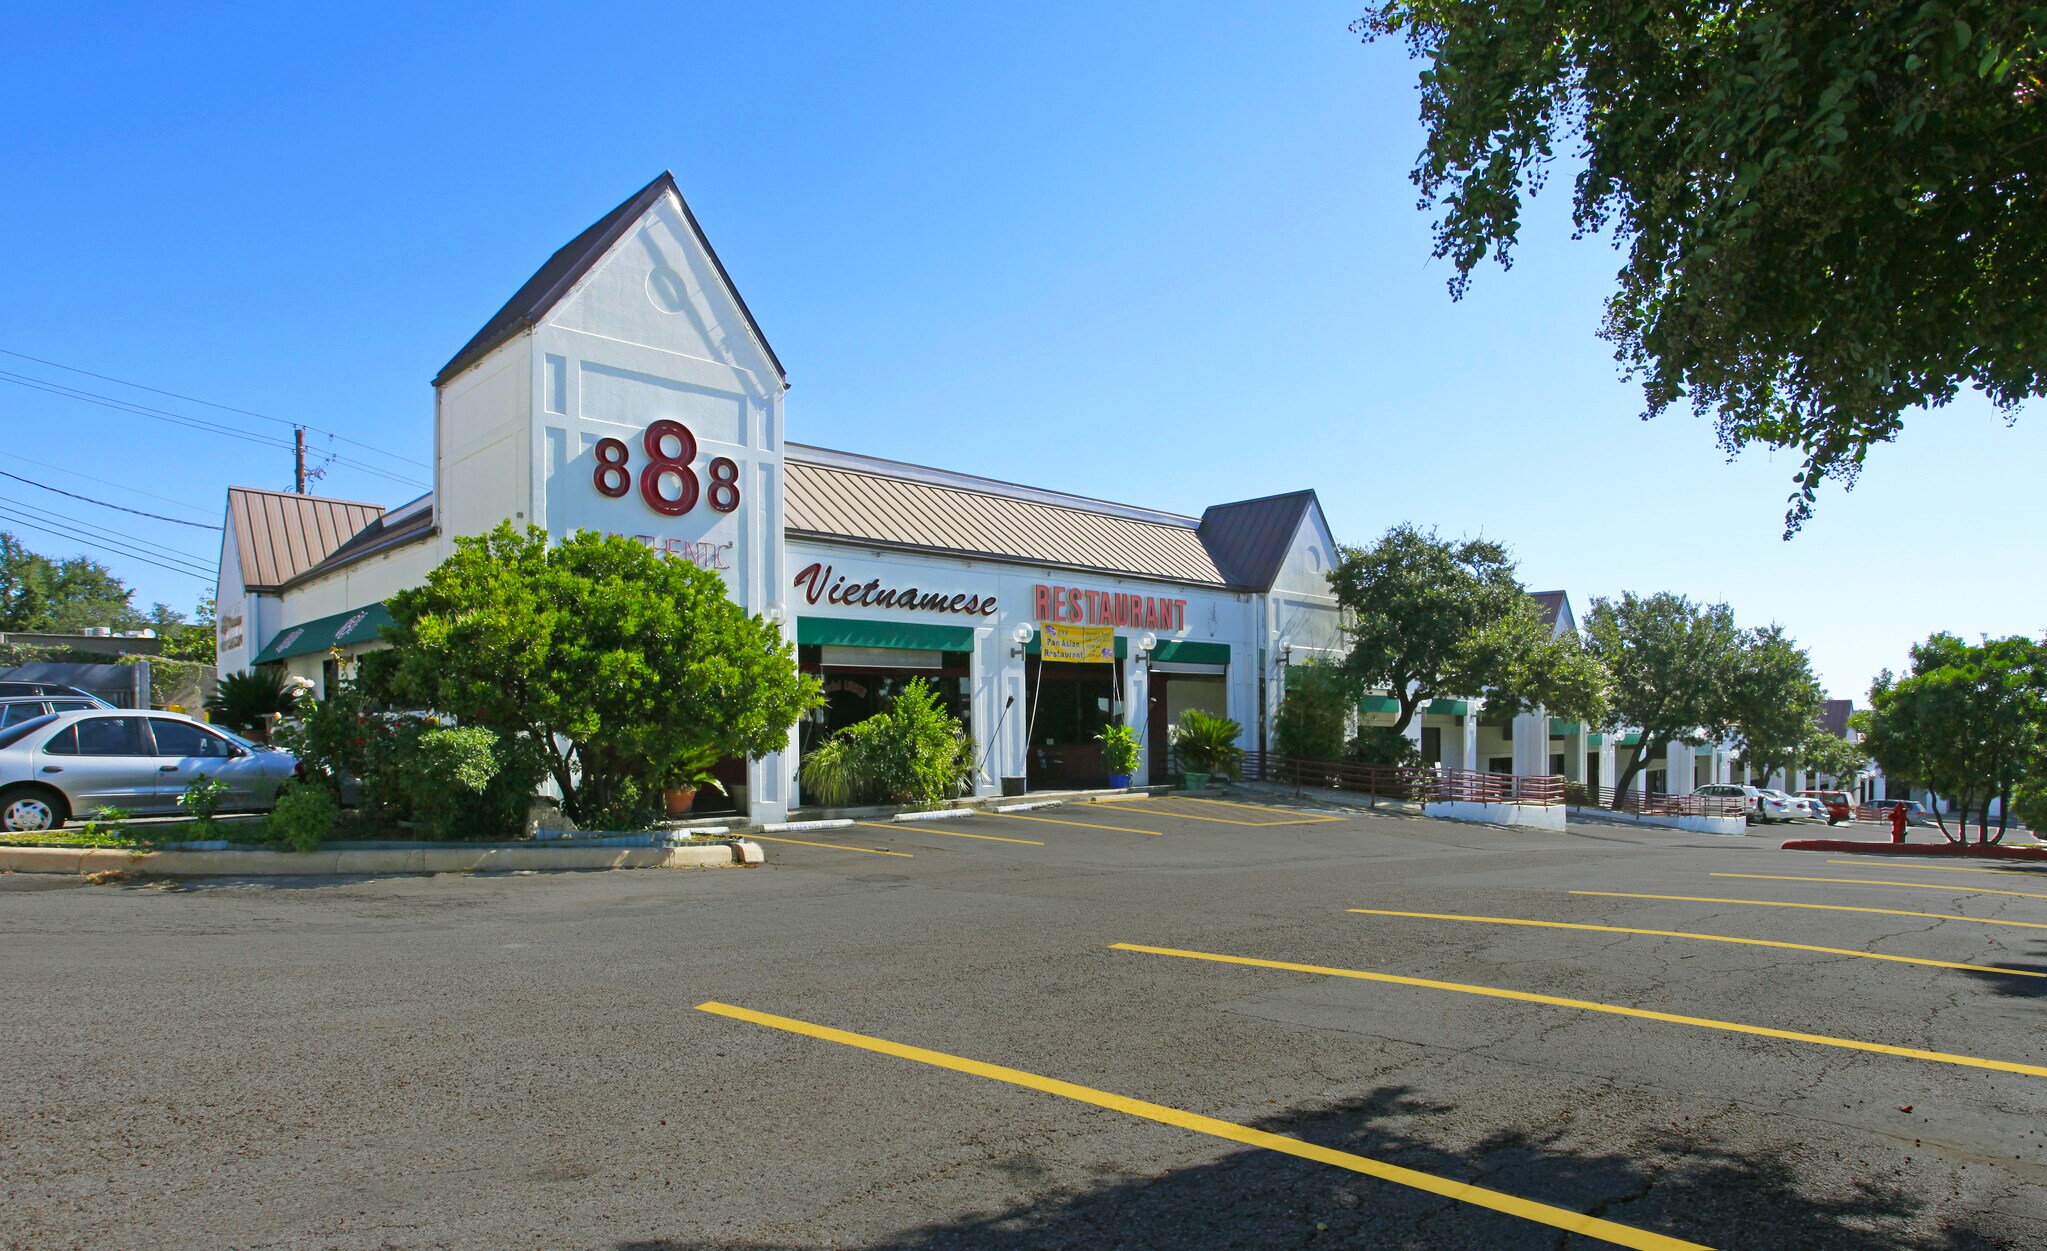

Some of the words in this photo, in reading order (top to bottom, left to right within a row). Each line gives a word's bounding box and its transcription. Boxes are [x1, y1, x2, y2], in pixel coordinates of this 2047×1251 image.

[592, 419, 740, 516] 888
[608, 531, 732, 569] THENTIC
[793, 562, 997, 616] Vietnamese
[1034, 584, 1187, 631] RESTAURANT
[1044, 649, 1083, 658] Restaurant
[1047, 638, 1060, 647] Pan
[1061, 639, 1080, 648] Asian
